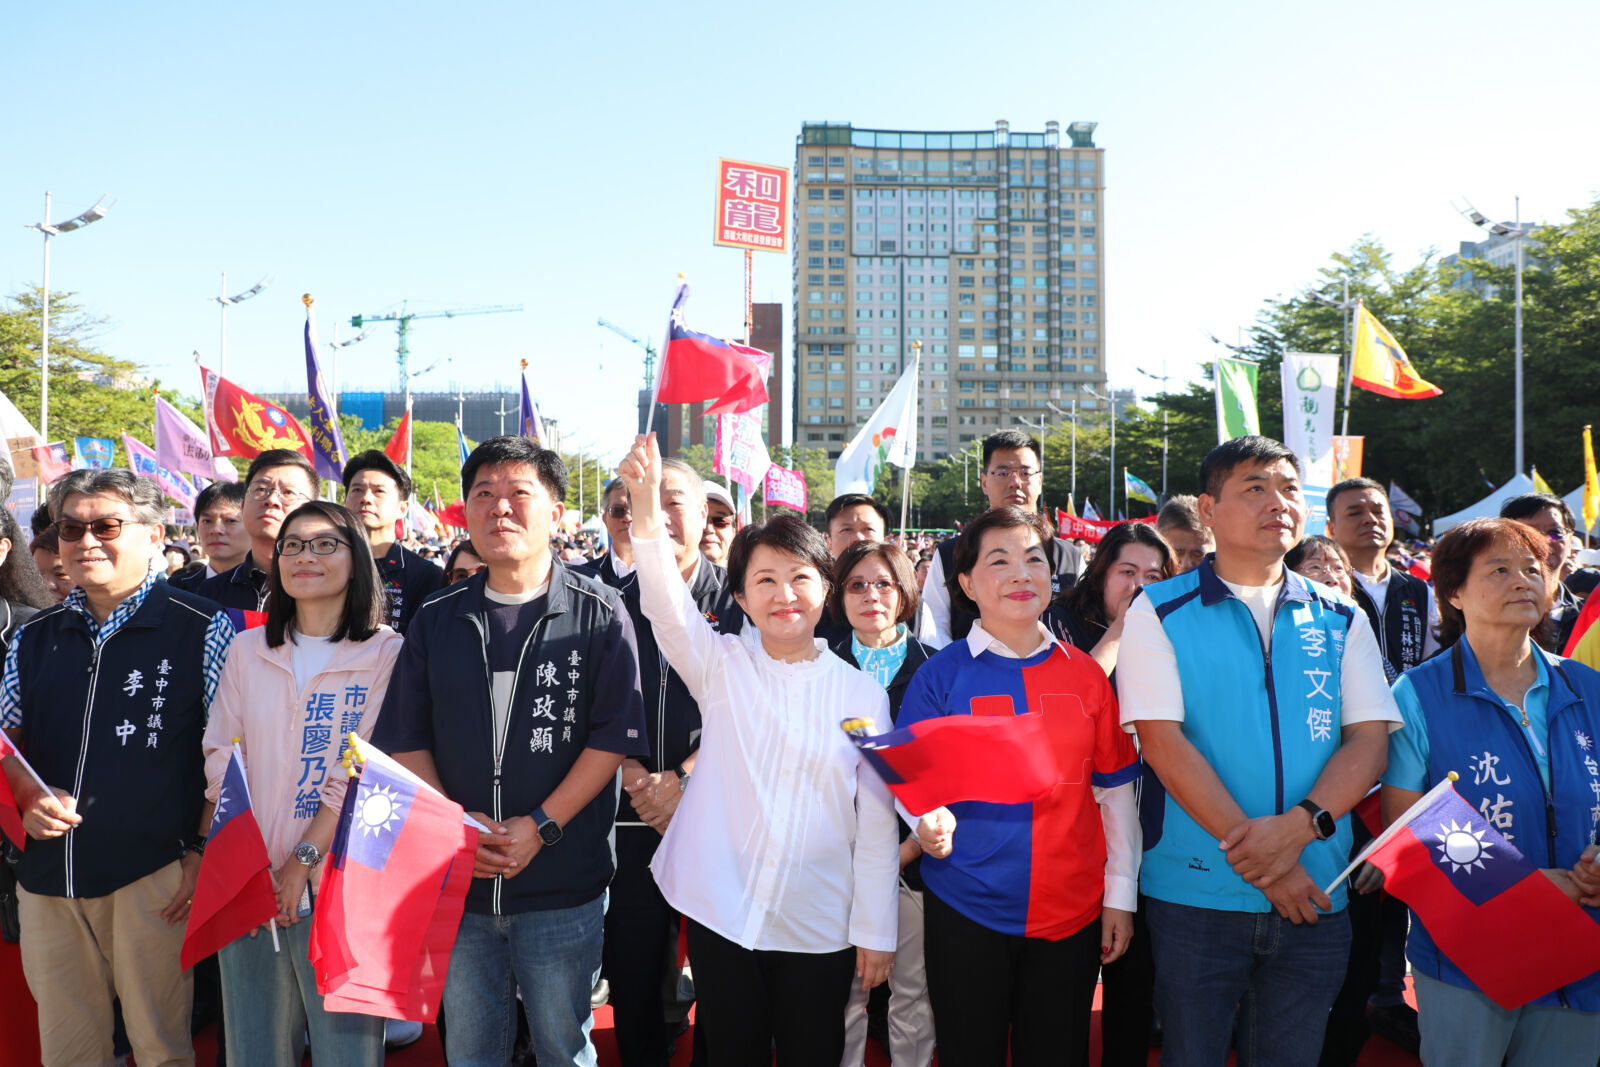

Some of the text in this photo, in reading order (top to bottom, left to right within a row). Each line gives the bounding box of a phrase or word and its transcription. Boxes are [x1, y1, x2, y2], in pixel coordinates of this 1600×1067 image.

[724, 168, 781, 202] 和
[724, 199, 781, 234] 龍
[115, 669, 144, 746] 李中
[146, 658, 173, 748] 臺中市議員
[530, 660, 560, 754] 陳政顯
[562, 649, 582, 743] 臺中市議員
[1299, 626, 1333, 742] 李文傑
[293, 693, 336, 819] 張廖乃綸
[1468, 751, 1515, 840] 沈佑
